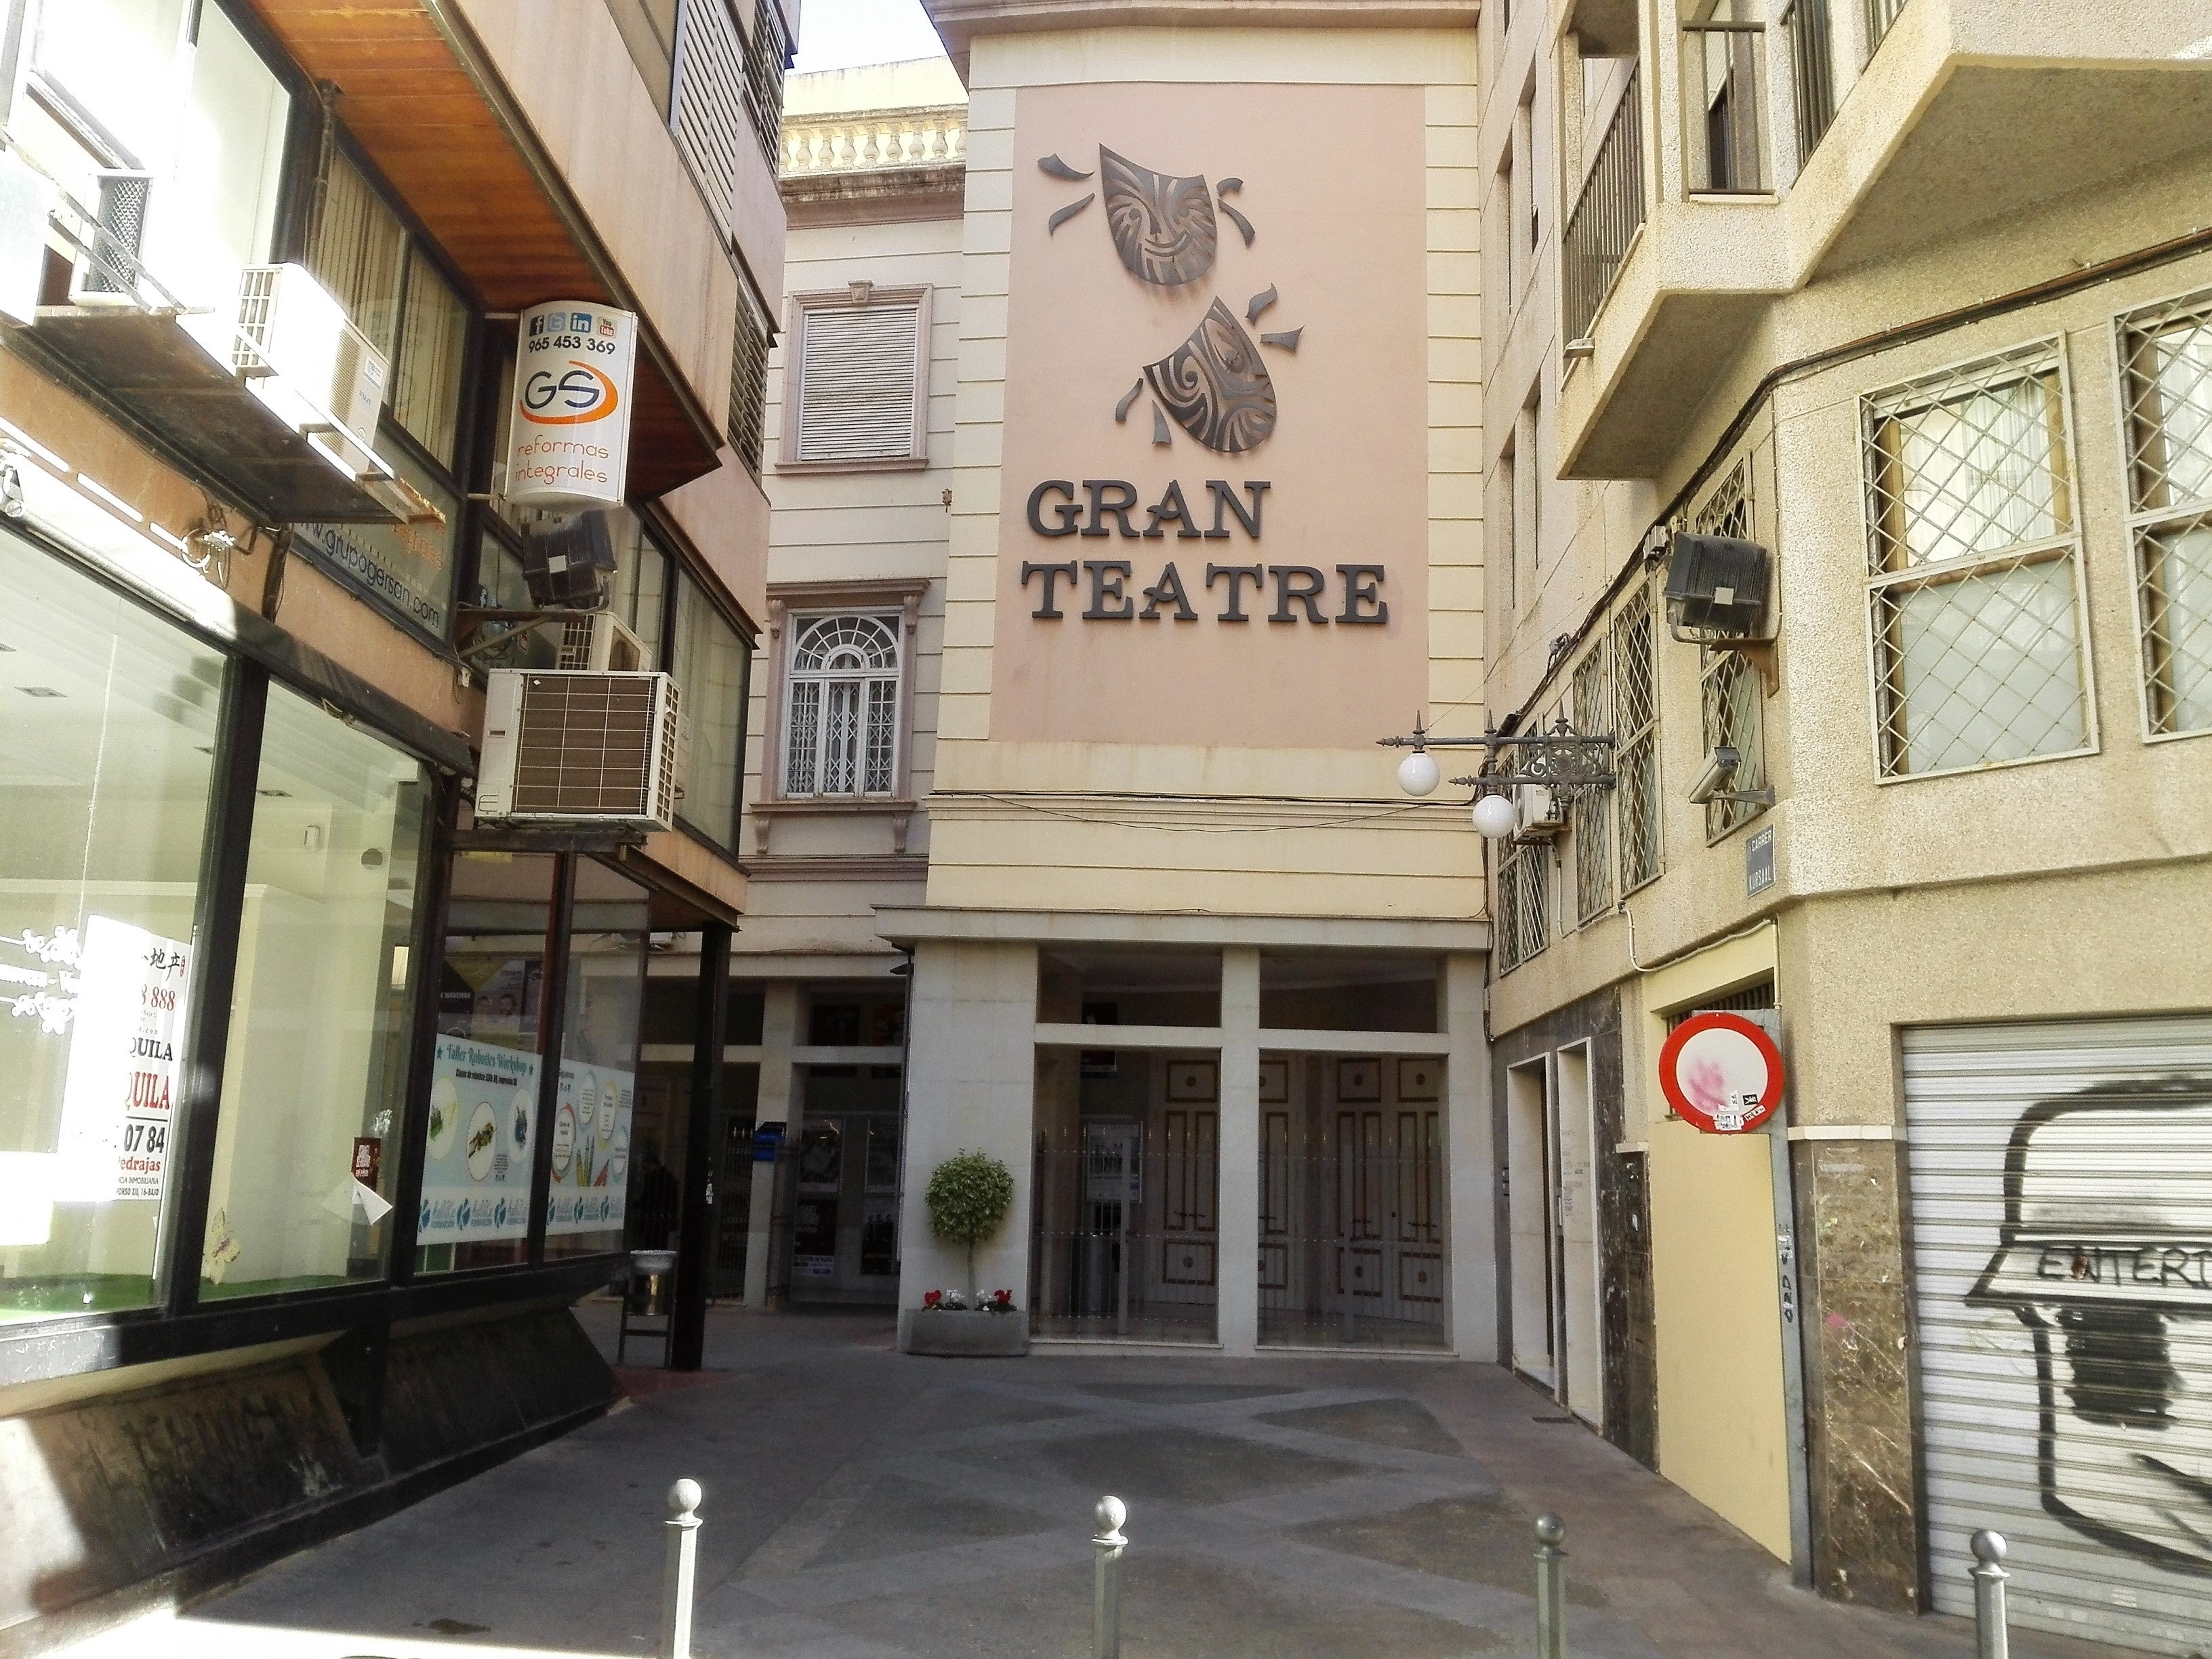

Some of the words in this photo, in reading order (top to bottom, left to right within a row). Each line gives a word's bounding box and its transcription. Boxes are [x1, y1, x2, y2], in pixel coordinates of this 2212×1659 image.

[529, 337, 550, 353] 965
[553, 335, 581, 349] 453
[586, 337, 615, 354] 369
[525, 370, 600, 409] GS
[517, 434, 609, 459] reformas
[516, 461, 608, 485] integrales
[1026, 479, 1271, 539] GRAN
[301, 523, 440, 629] w.grupogersan.com
[1021, 560, 1388, 624] TEATRE
[1751, 830, 1772, 852] CARRER
[151, 986, 176, 1011] 888
[447, 1044, 466, 1062] Taller
[497, 1053, 527, 1076] Workshop
[124, 1124, 144, 1152] 07
[146, 1126, 165, 1153] 84
[119, 1155, 161, 1174] edrajas
